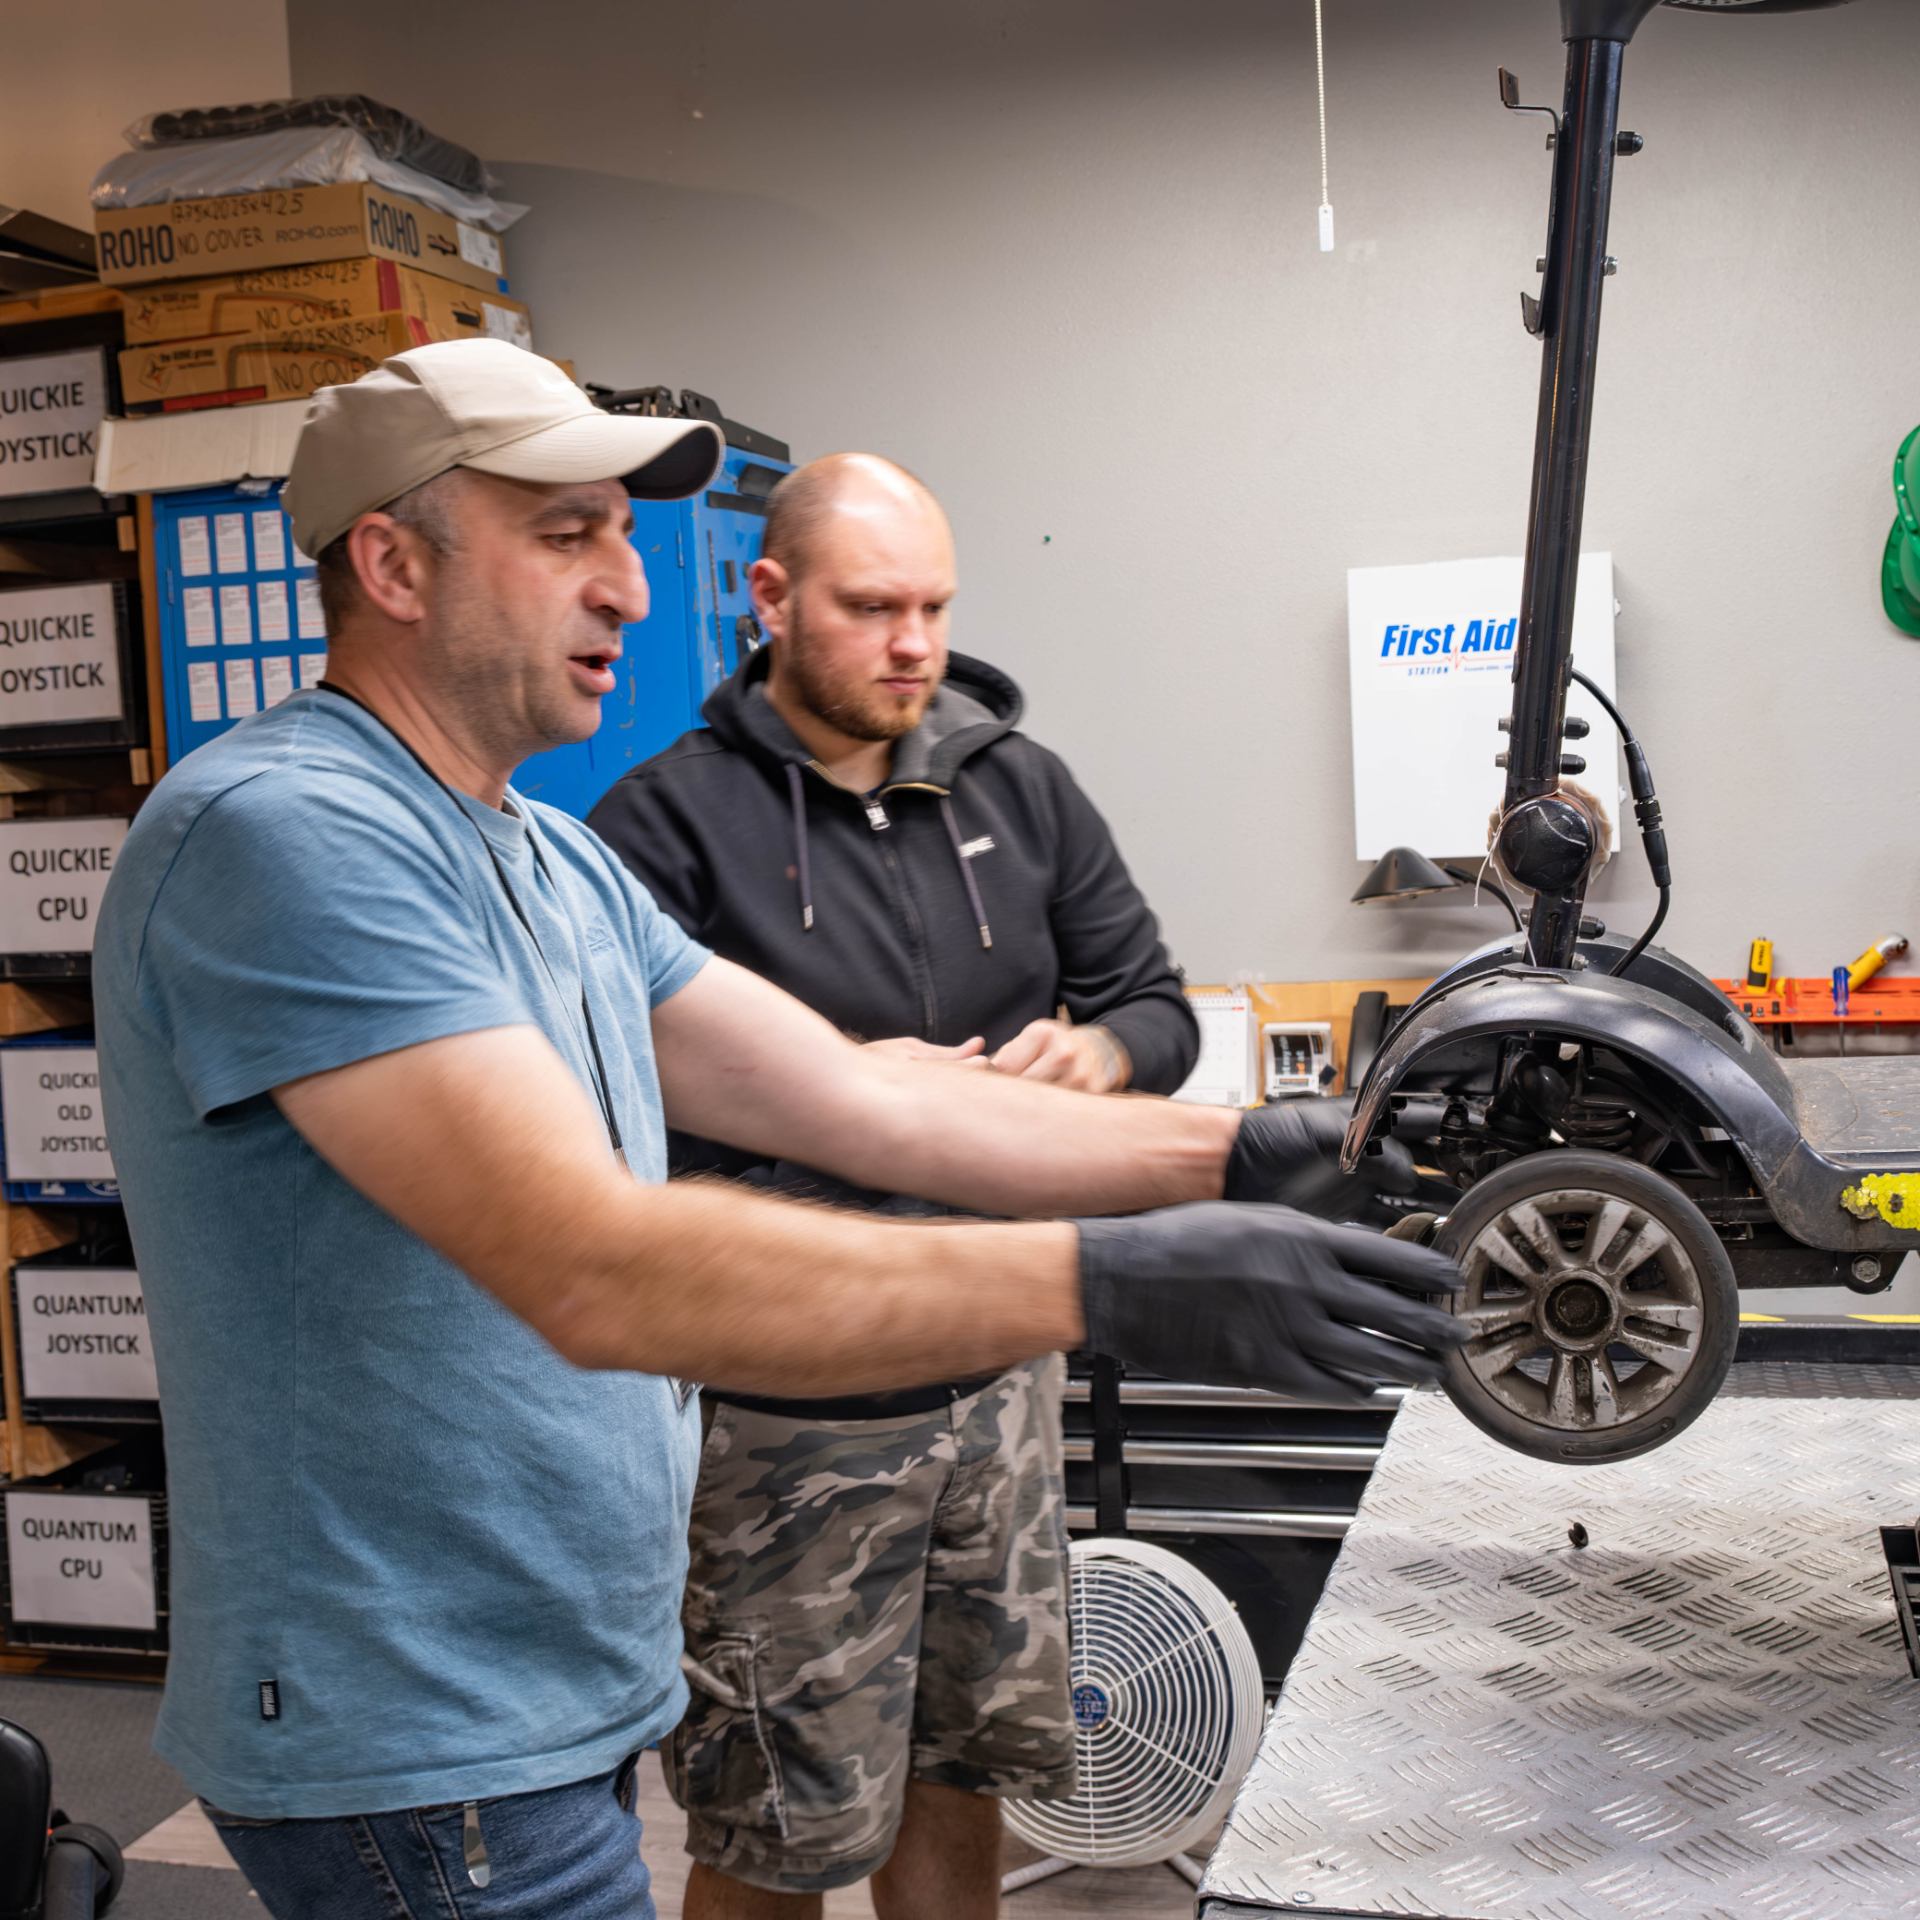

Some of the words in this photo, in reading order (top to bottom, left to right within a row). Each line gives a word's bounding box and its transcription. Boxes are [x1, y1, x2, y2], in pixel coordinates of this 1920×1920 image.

[178, 232, 200, 255] NO
[205, 226, 263, 253] COVER
[276, 224, 360, 243] ROHO.com
[368, 197, 420, 257] ROHO
[101, 224, 175, 271] ROHO
[256, 306, 280, 330] NO
[287, 299, 352, 326] COVER
[272, 363, 304, 392] NO
[0, 381, 84, 418] UICKIE
[0, 430, 95, 465] YSTICK
[0, 613, 95, 648] QUICKIE
[1381, 624, 1456, 657] First
[1461, 618, 1517, 653] Aid
[0, 662, 105, 694] OYSTICK
[10, 847, 112, 876] QUICKIE
[37, 897, 88, 921] CPU
[39, 1072, 99, 1091] QUICKI
[57, 1104, 93, 1121] OLD
[41, 1135, 109, 1153] JOYSTIC
[33, 1295, 145, 1317] QUANTUM
[47, 1334, 140, 1354] JOYSTICK
[22, 1518, 137, 1542] QUANTUM
[60, 1558, 103, 1580] CPU
